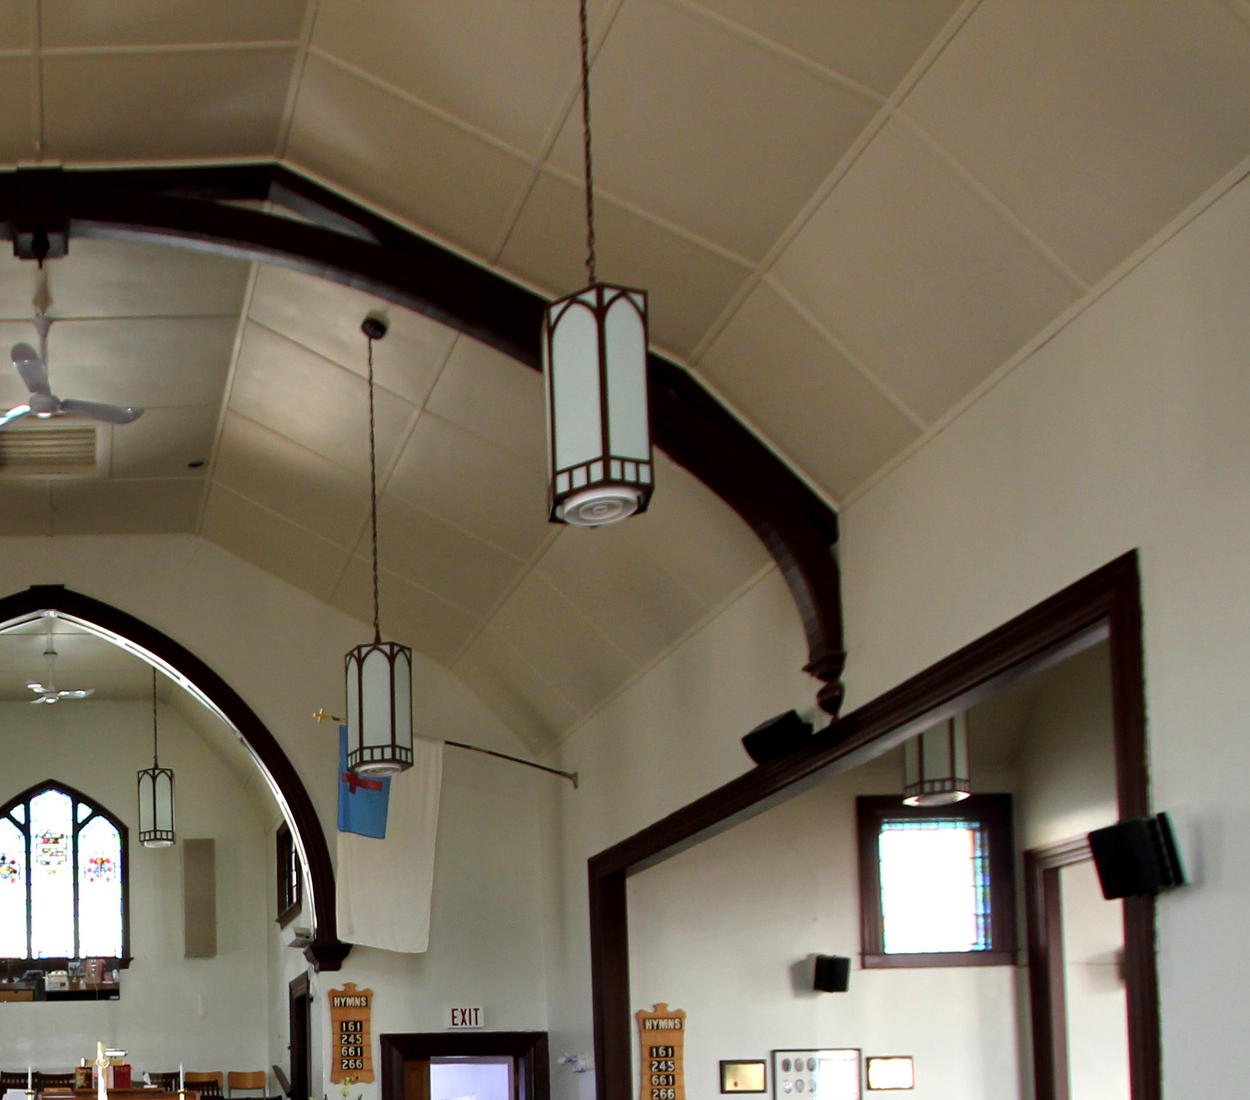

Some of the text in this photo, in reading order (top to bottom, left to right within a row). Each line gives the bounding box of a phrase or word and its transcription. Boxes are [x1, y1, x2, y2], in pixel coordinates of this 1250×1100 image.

[334, 997, 368, 1008] HYMNS
[451, 1008, 480, 1027] EXIT
[342, 1022, 363, 1032] 161
[645, 1018, 682, 1030] HYMNS
[342, 1035, 363, 1045] 245
[342, 1047, 363, 1057] 661
[652, 1047, 674, 1058] 161
[342, 1060, 363, 1070] 266
[652, 1061, 675, 1072] 245
[652, 1075, 674, 1086] 661
[652, 1089, 675, 1100] 266
